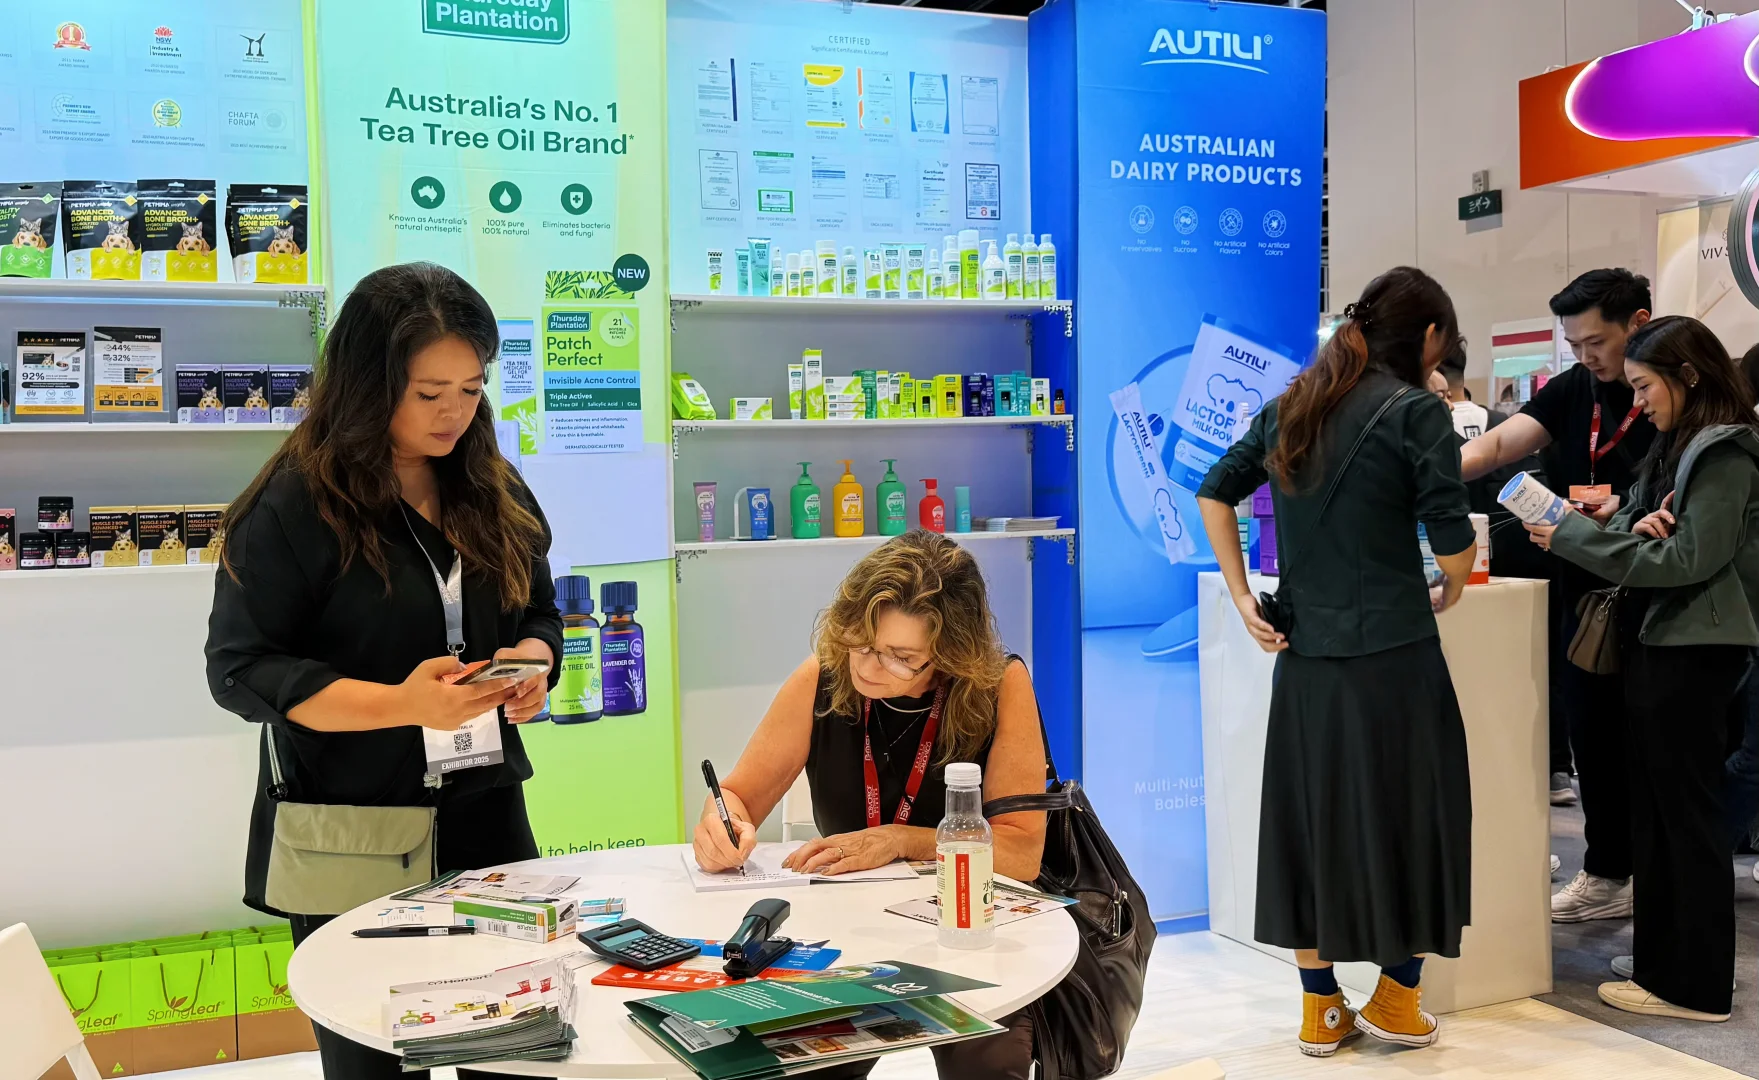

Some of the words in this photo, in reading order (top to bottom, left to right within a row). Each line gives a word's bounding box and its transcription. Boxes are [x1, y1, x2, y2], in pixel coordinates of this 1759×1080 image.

[436, 1, 558, 32] Plantation
[155, 36, 172, 44] NSW
[828, 35, 871, 47] CERTIFIED
[385, 87, 546, 120] Australia's
[554, 100, 599, 123] No.
[606, 102, 617, 123] 1
[228, 111, 259, 120] CHAFTA
[228, 118, 256, 127] FORUM
[360, 117, 414, 143] Tea
[422, 123, 489, 149] Tree
[497, 128, 535, 152] Oil
[1139, 133, 1275, 158] AUSTRALIAN
[1111, 160, 1179, 181] DAIRY
[1187, 163, 1302, 187] PRODUCTS
[144, 209, 188, 217] ADVANCED
[71, 215, 92, 223] BONE
[389, 214, 415, 223] Known
[416, 216, 426, 224] as
[428, 216, 468, 226] Australia's
[486, 219, 506, 227] 100%
[507, 221, 525, 230] pure
[394, 223, 423, 231] natural
[424, 224, 462, 234] antiseptic
[542, 221, 579, 229] Eliminates
[580, 222, 611, 230] bacteria
[481, 227, 501, 235] 100%
[502, 227, 530, 236] natural
[575, 229, 594, 239] fungi
[1223, 240, 1246, 248] Artificial
[1701, 248, 1723, 260] VIV
[617, 268, 646, 280] NEW
[552, 314, 586, 324] Thursday
[612, 318, 622, 326] 21
[550, 321, 588, 330] Plantation
[111, 344, 132, 352] 44%
[547, 336, 592, 351] Patch
[112, 354, 131, 362] 32%
[547, 352, 604, 366] Perfect
[22, 372, 45, 381] 92%
[548, 376, 582, 385] Invisible
[584, 376, 604, 385] Acne
[606, 376, 637, 385] Control
[549, 393, 568, 401] Triple
[569, 392, 593, 400] Actives
[1186, 398, 1236, 430] LACTOF
[1192, 418, 1211, 436] MILK
[1212, 427, 1233, 443] POW
[563, 639, 588, 647] ursday
[568, 663, 584, 671] TREE
[584, 662, 596, 670] OIL
[441, 758, 474, 770] EXHIBITOR
[473, 755, 490, 764] 2025
[1134, 774, 1205, 795] Multi-Nut
[1155, 794, 1207, 812] Babies
[547, 843, 565, 857] to
[569, 838, 604, 856] help
[607, 836, 646, 850] keep
[517, 924, 538, 932] STAPLER
[622, 972, 727, 986] LABELS
[251, 994, 295, 1009] Spring
[147, 1003, 220, 1024] SpringLeaf
[77, 1013, 118, 1033] gLeaf
